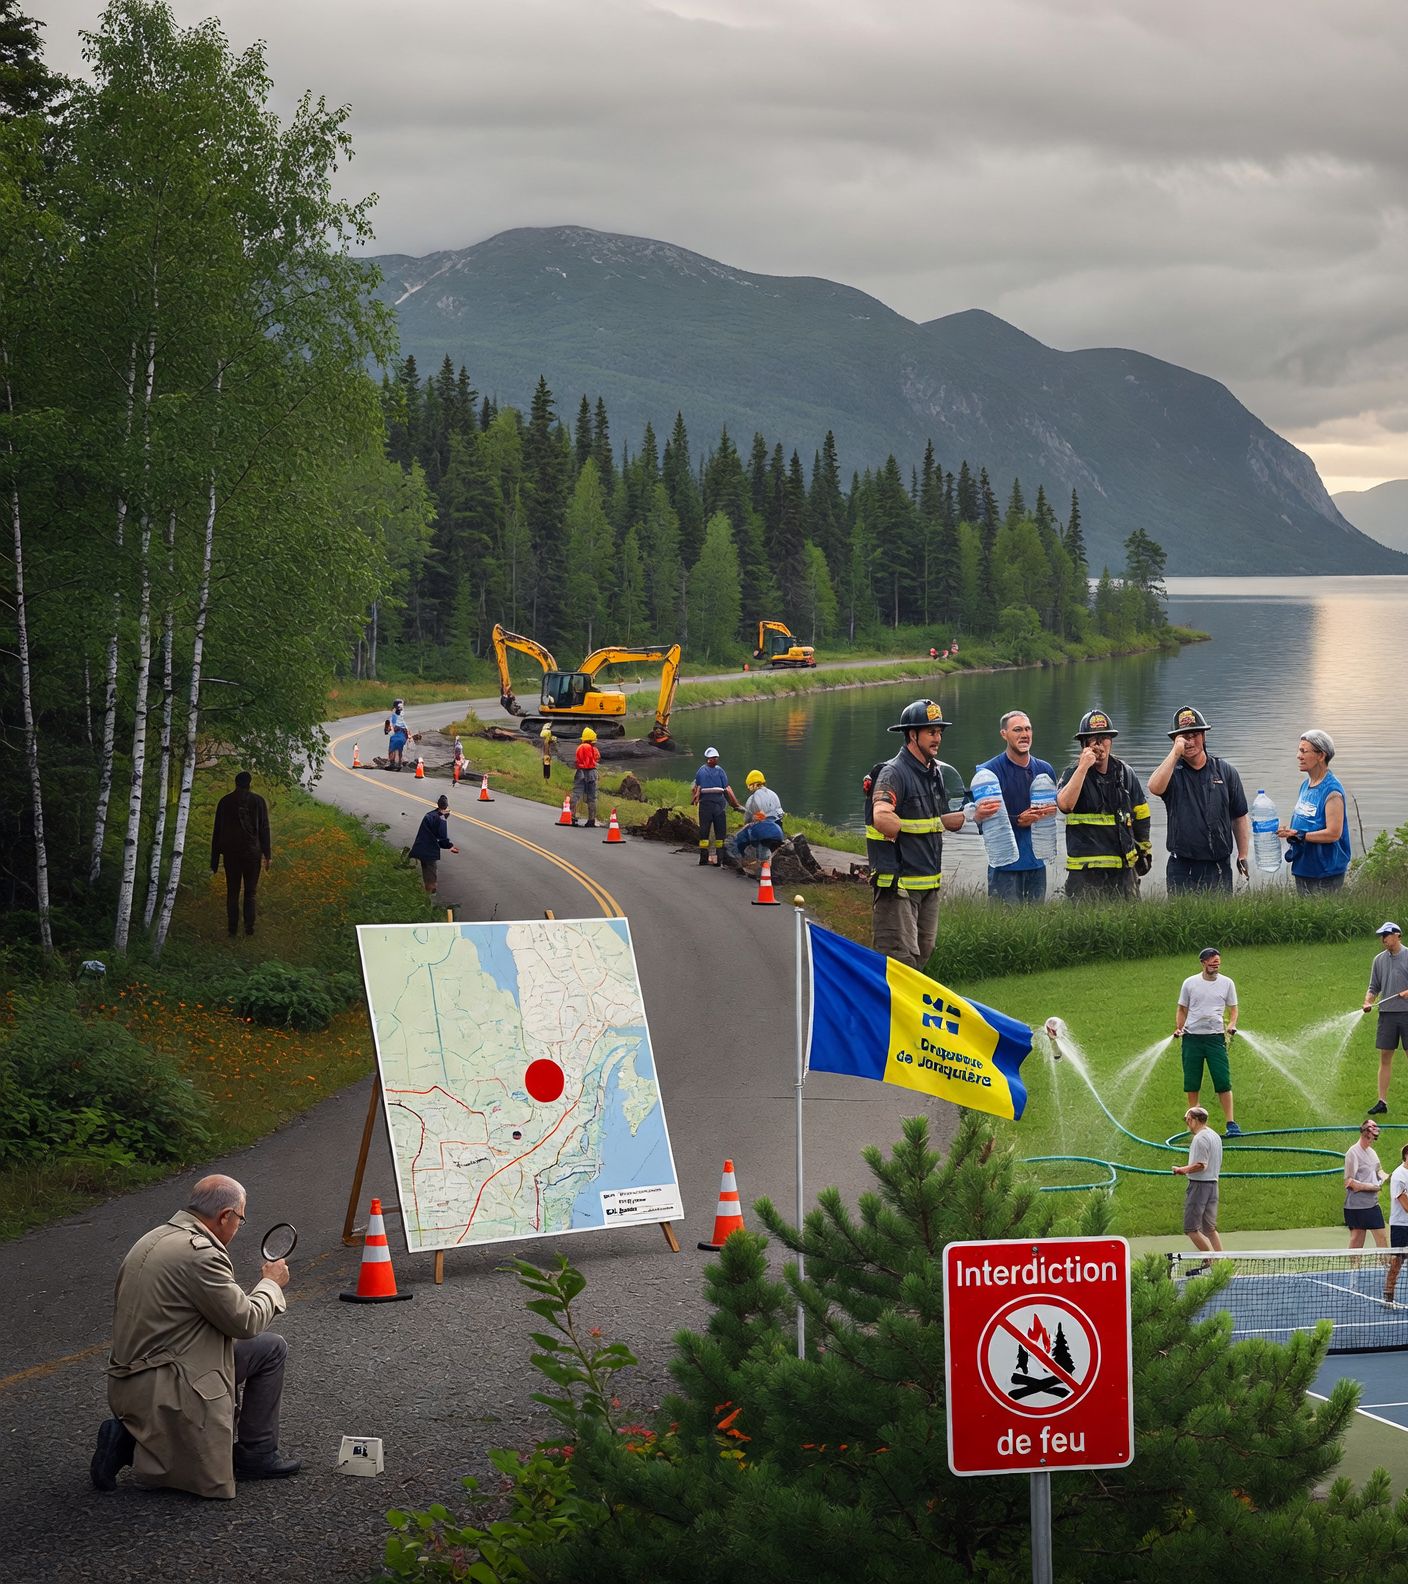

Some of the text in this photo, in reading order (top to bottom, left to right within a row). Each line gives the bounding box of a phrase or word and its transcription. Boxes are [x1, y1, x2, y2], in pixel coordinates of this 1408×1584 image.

[956, 1255, 1118, 1287] Interdiction
[997, 1425, 1085, 1456] de feu
